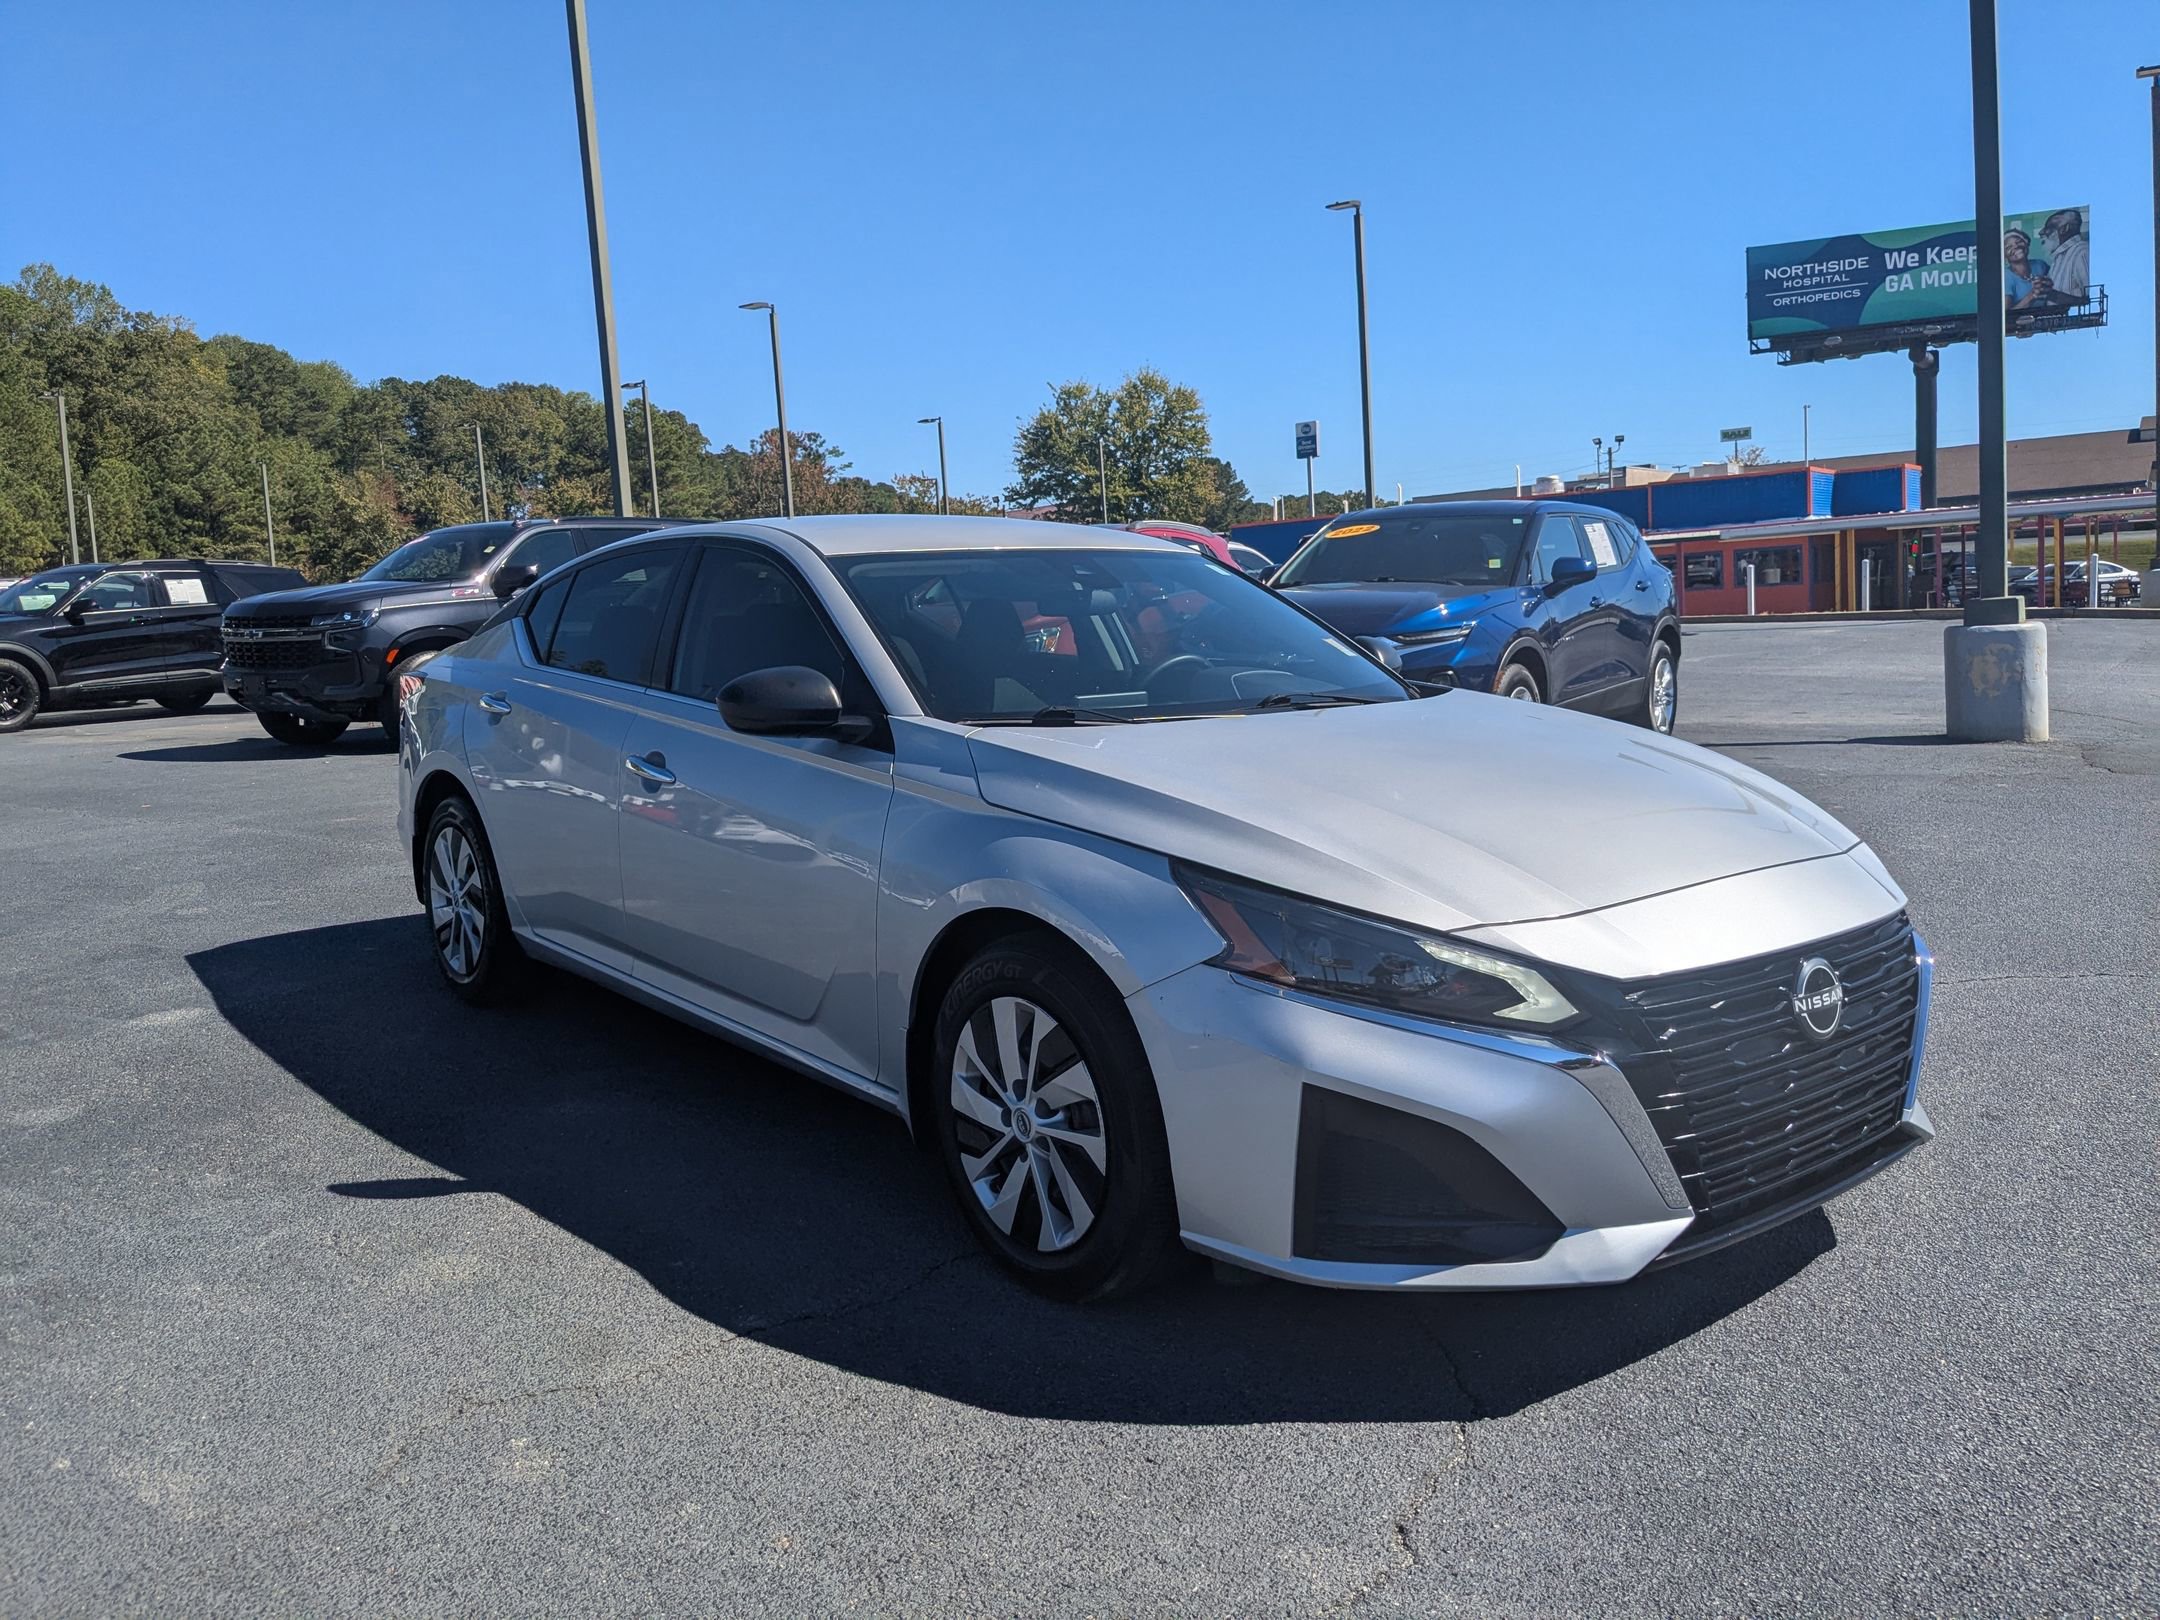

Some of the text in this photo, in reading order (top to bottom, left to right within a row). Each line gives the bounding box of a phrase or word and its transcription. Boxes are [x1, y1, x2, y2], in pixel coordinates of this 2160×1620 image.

[1765, 257, 1869, 280] NORTHSIDE
[1884, 250, 1920, 270] We
[1783, 274, 1851, 289] HOSPITAL
[1885, 264, 1978, 292] GA Movi
[1773, 288, 1862, 307] ORTHOPEDICS
[1794, 986, 1842, 1012] NISSAN
